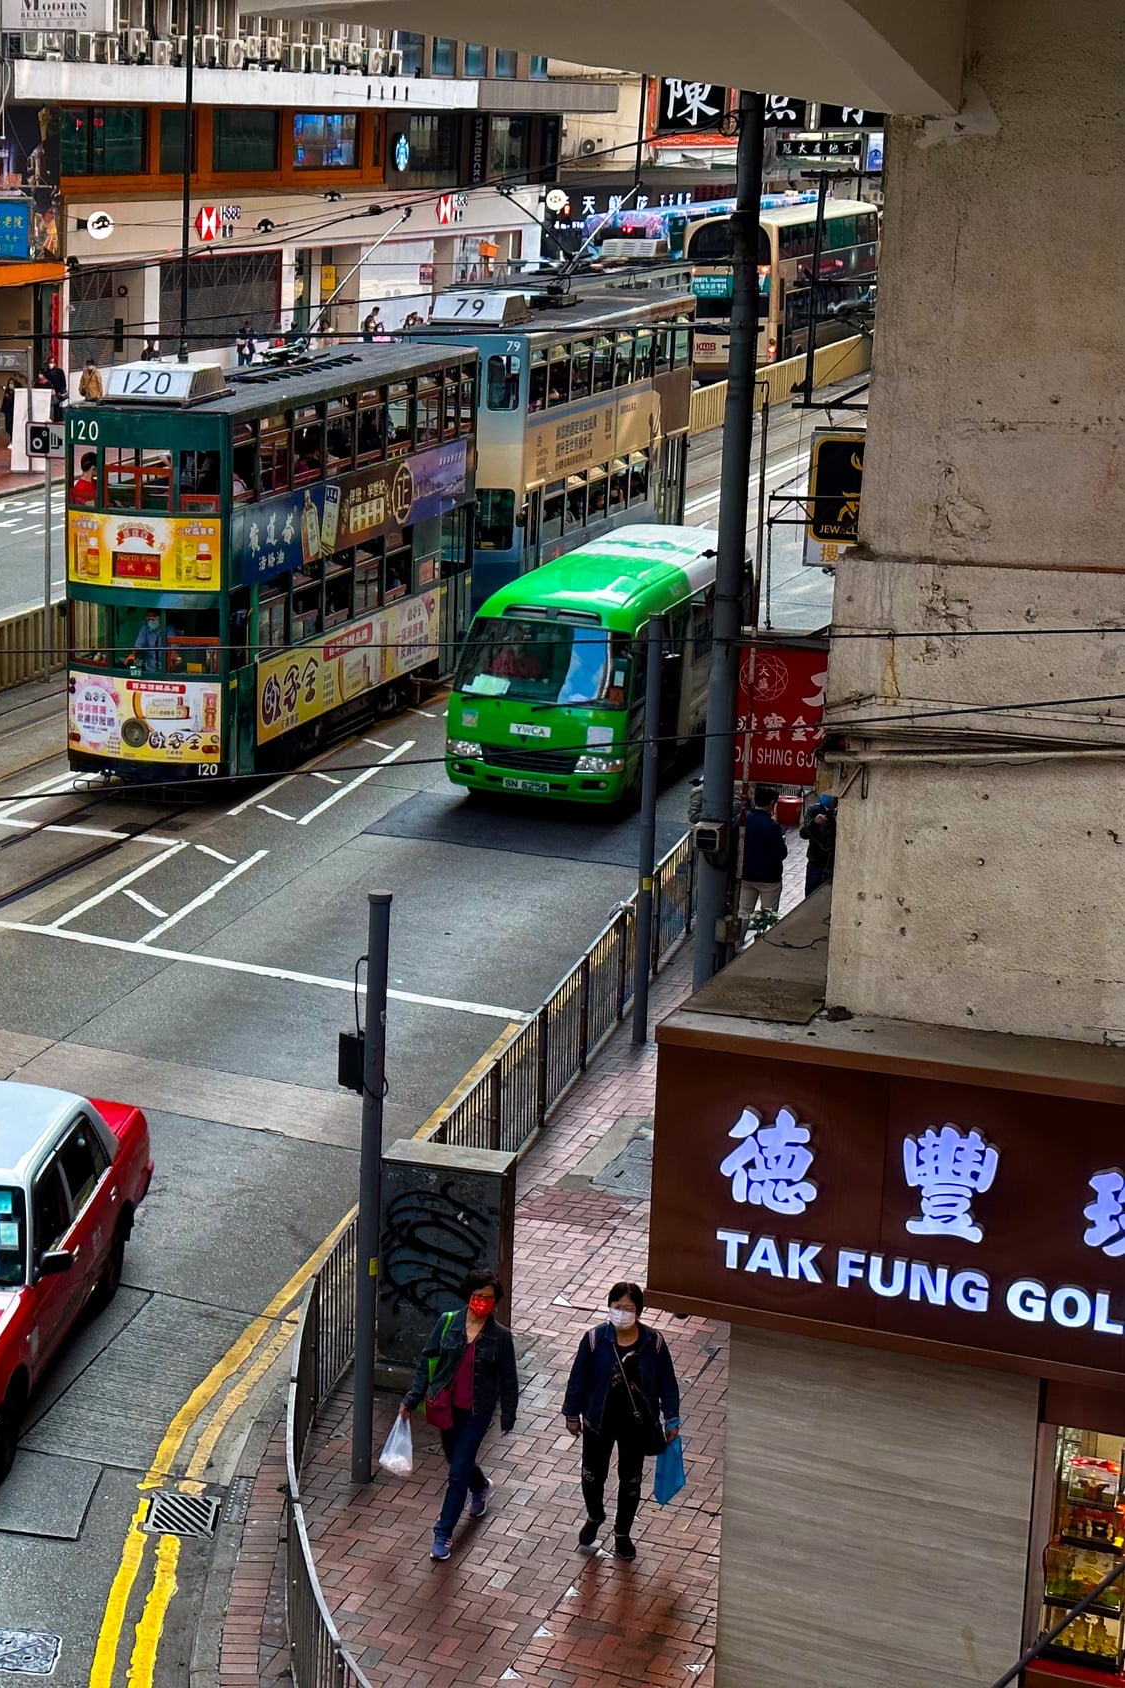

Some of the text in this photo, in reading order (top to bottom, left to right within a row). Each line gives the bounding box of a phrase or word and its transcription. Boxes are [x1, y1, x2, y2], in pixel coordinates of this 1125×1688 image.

[474, 117, 483, 184] STARBUCKS
[453, 298, 485, 317] 79
[506, 340, 521, 352] 79
[696, 342, 717, 351] KMB
[123, 371, 172, 395] 120
[70, 419, 99, 441] 120
[515, 724, 546, 736] YWCA
[757, 747, 793, 767] SHING
[197, 763, 219, 776] 120
[505, 779, 518, 788] SN
[715, 1228, 826, 1285] TAK
[836, 1246, 990, 1314] FUNG
